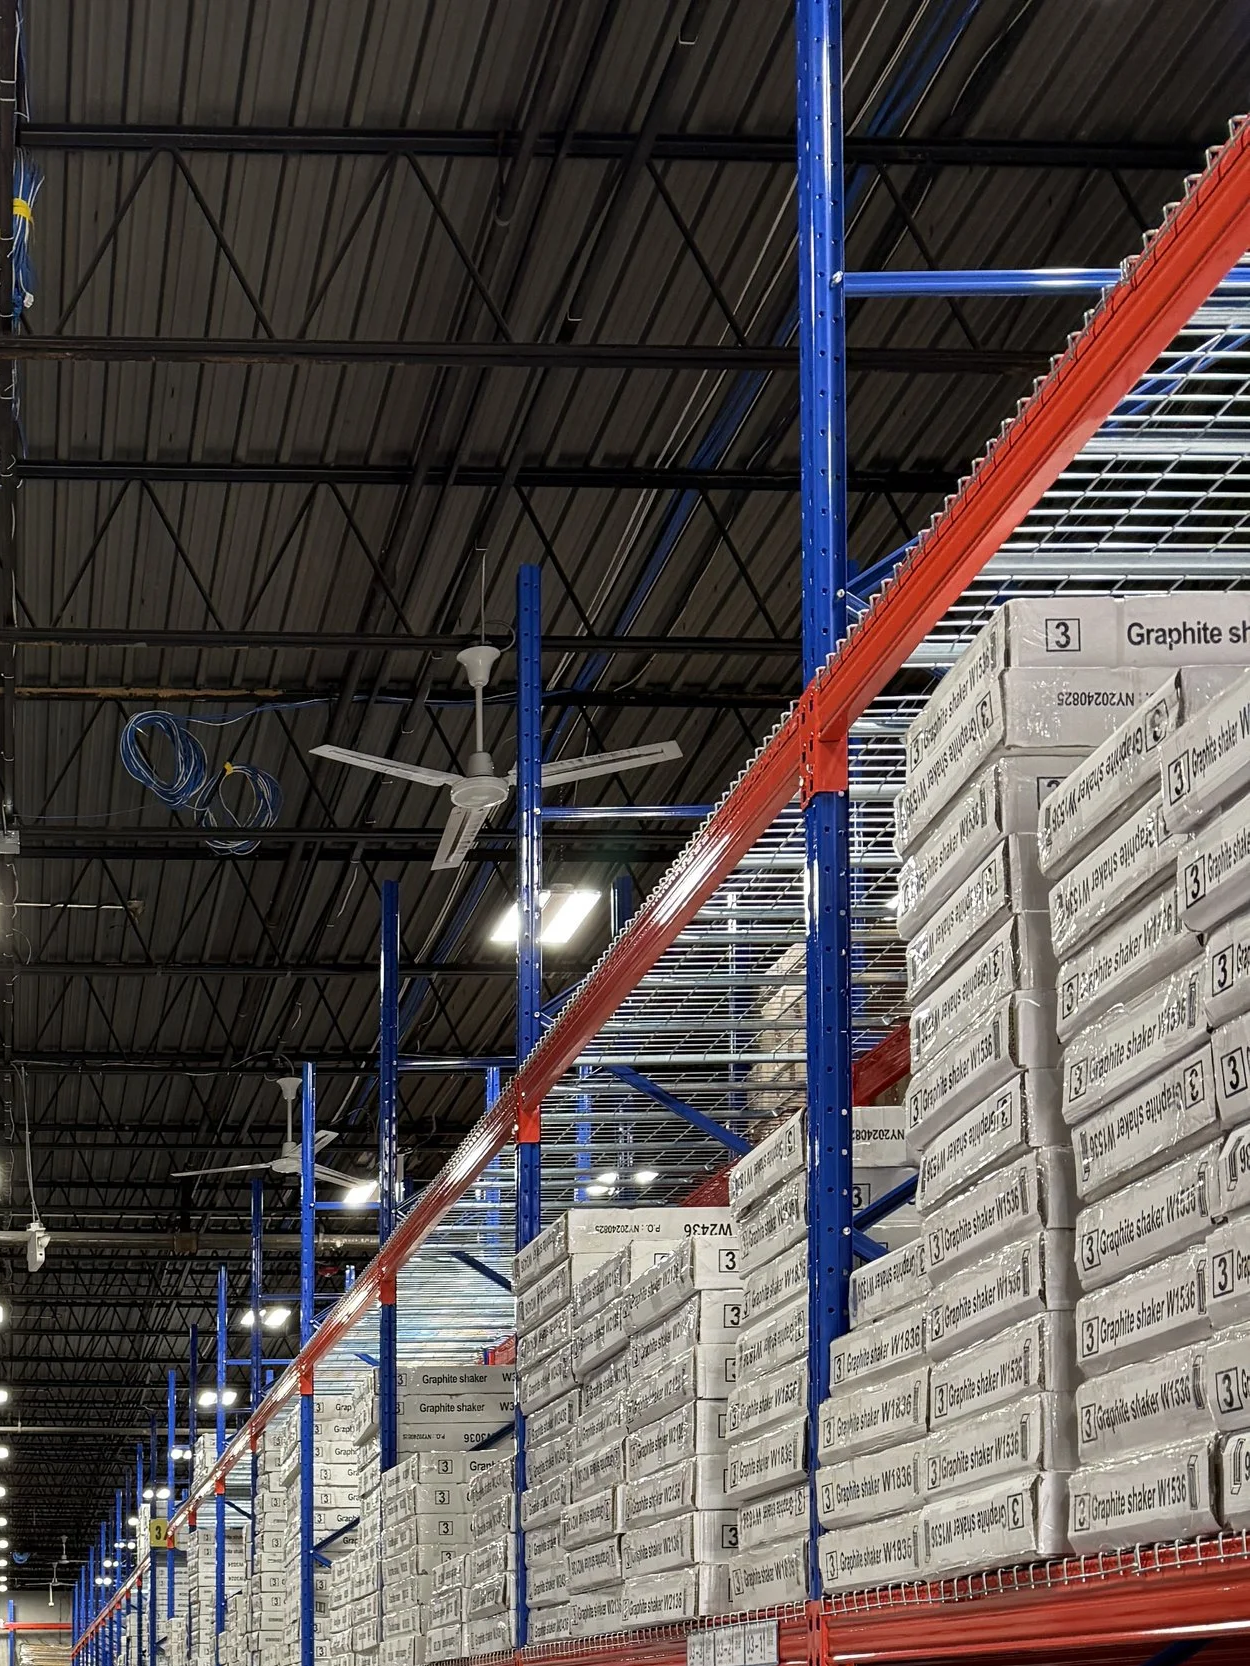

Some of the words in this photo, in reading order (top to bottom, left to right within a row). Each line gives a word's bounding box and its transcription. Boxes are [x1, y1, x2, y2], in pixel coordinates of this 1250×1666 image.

[1055, 621, 1071, 649] 3
[1127, 619, 1223, 650] Graphite
[1057, 692, 1135, 706] NY20240825
[684, 1223, 733, 1237] W2436
[1085, 1234, 1095, 1265] 3
[1100, 1217, 1135, 1255] Graphite
[1136, 1199, 1165, 1236] shaker
[1166, 1184, 1197, 1224] W1536
[1085, 1322, 1095, 1353] 3
[1100, 1309, 1135, 1345] Graphite
[1136, 1293, 1165, 1328] shaker
[1166, 1280, 1196, 1317] W1536
[422, 1374, 457, 1385] Graphite
[460, 1374, 487, 1383] shaker
[930, 1463, 938, 1486] 3
[941, 1453, 969, 1480] Graphite
[970, 1444, 994, 1469] shaker
[995, 1434, 1019, 1462] W1536
[824, 1487, 832, 1510] 3
[836, 1483, 860, 1504] Graphite
[860, 1477, 880, 1499] shaker
[882, 1464, 912, 1488] W1836
[1078, 1498, 1087, 1528] 3
[1091, 1488, 1125, 1525] Graphite
[1127, 1479, 1157, 1512] shaker
[1158, 1468, 1187, 1504] W1536
